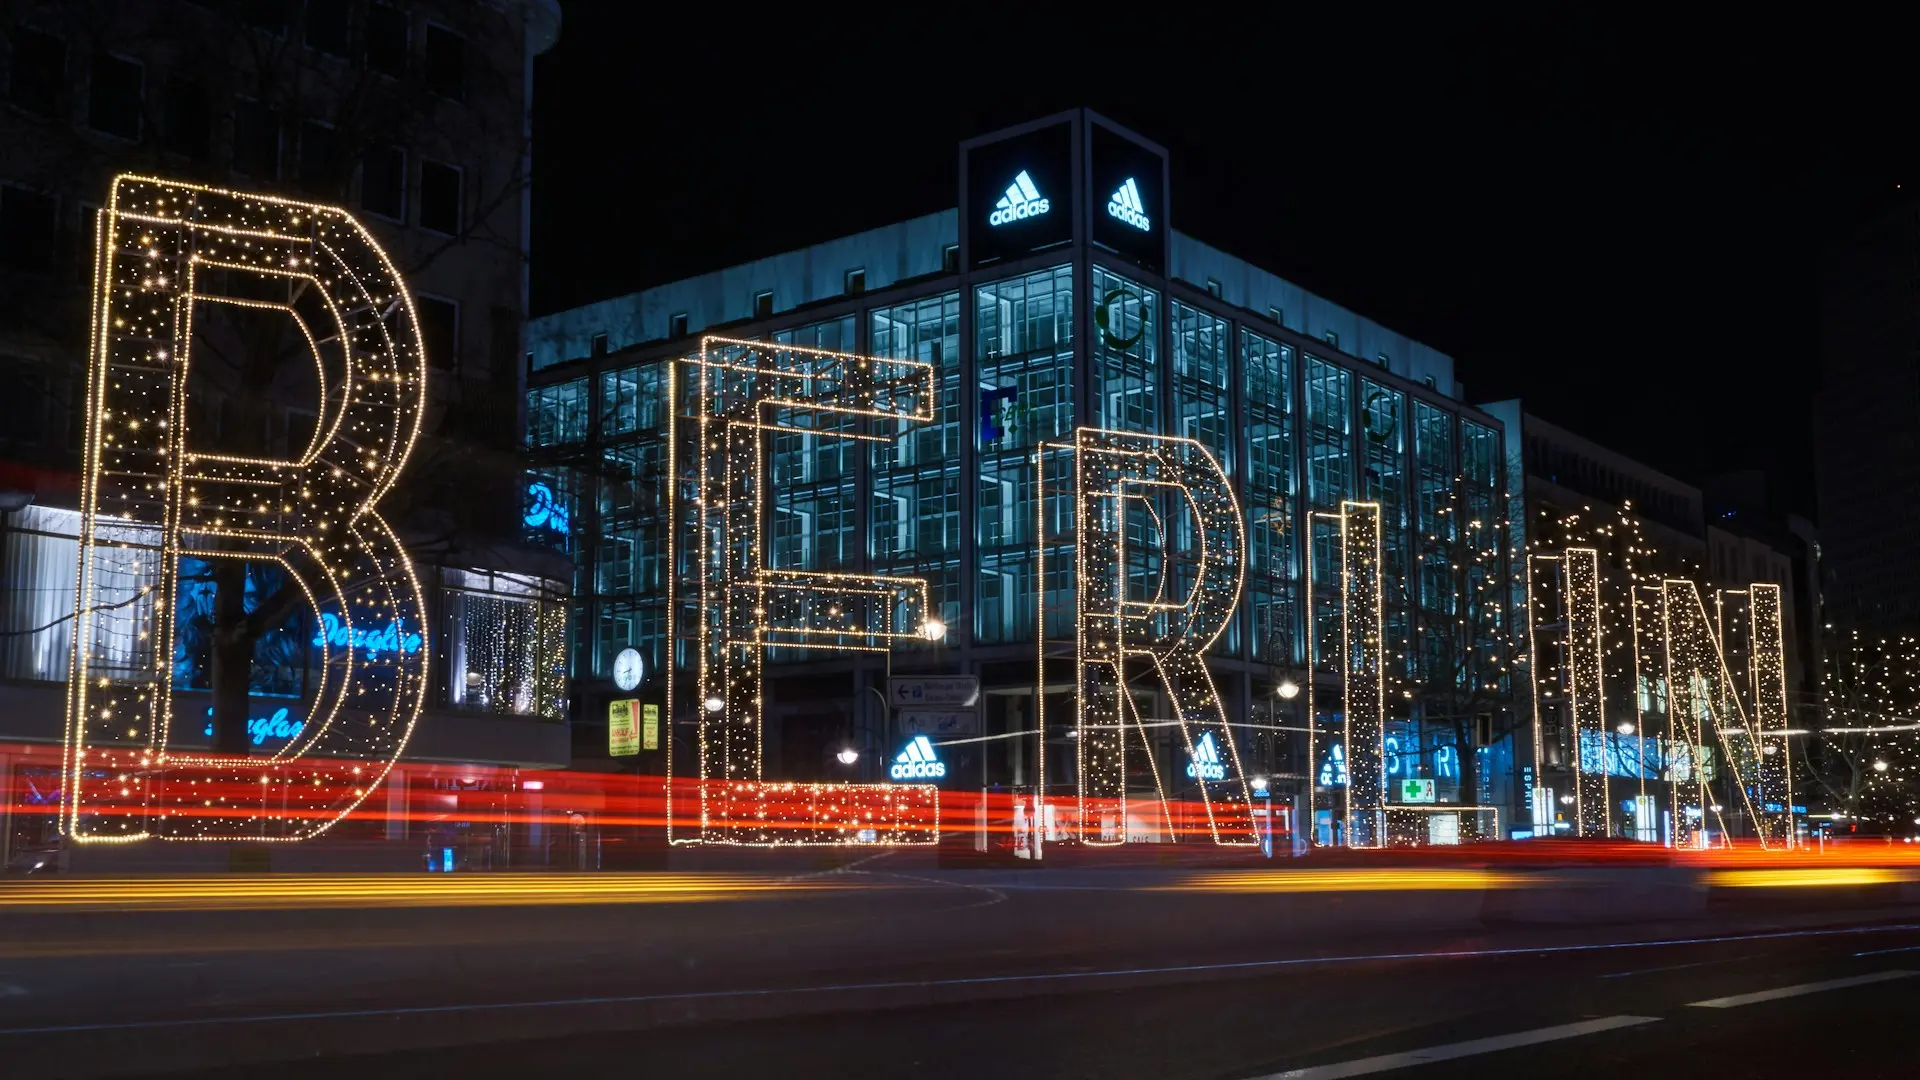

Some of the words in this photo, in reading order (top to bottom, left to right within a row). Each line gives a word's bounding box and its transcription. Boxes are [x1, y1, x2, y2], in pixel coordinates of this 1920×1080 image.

[990, 198, 1050, 226] adidas
[1108, 201, 1150, 231] adidas
[312, 612, 422, 660] Douglas
[891, 760, 945, 779] adidas
[1523, 766, 1533, 810] ESPRIT
